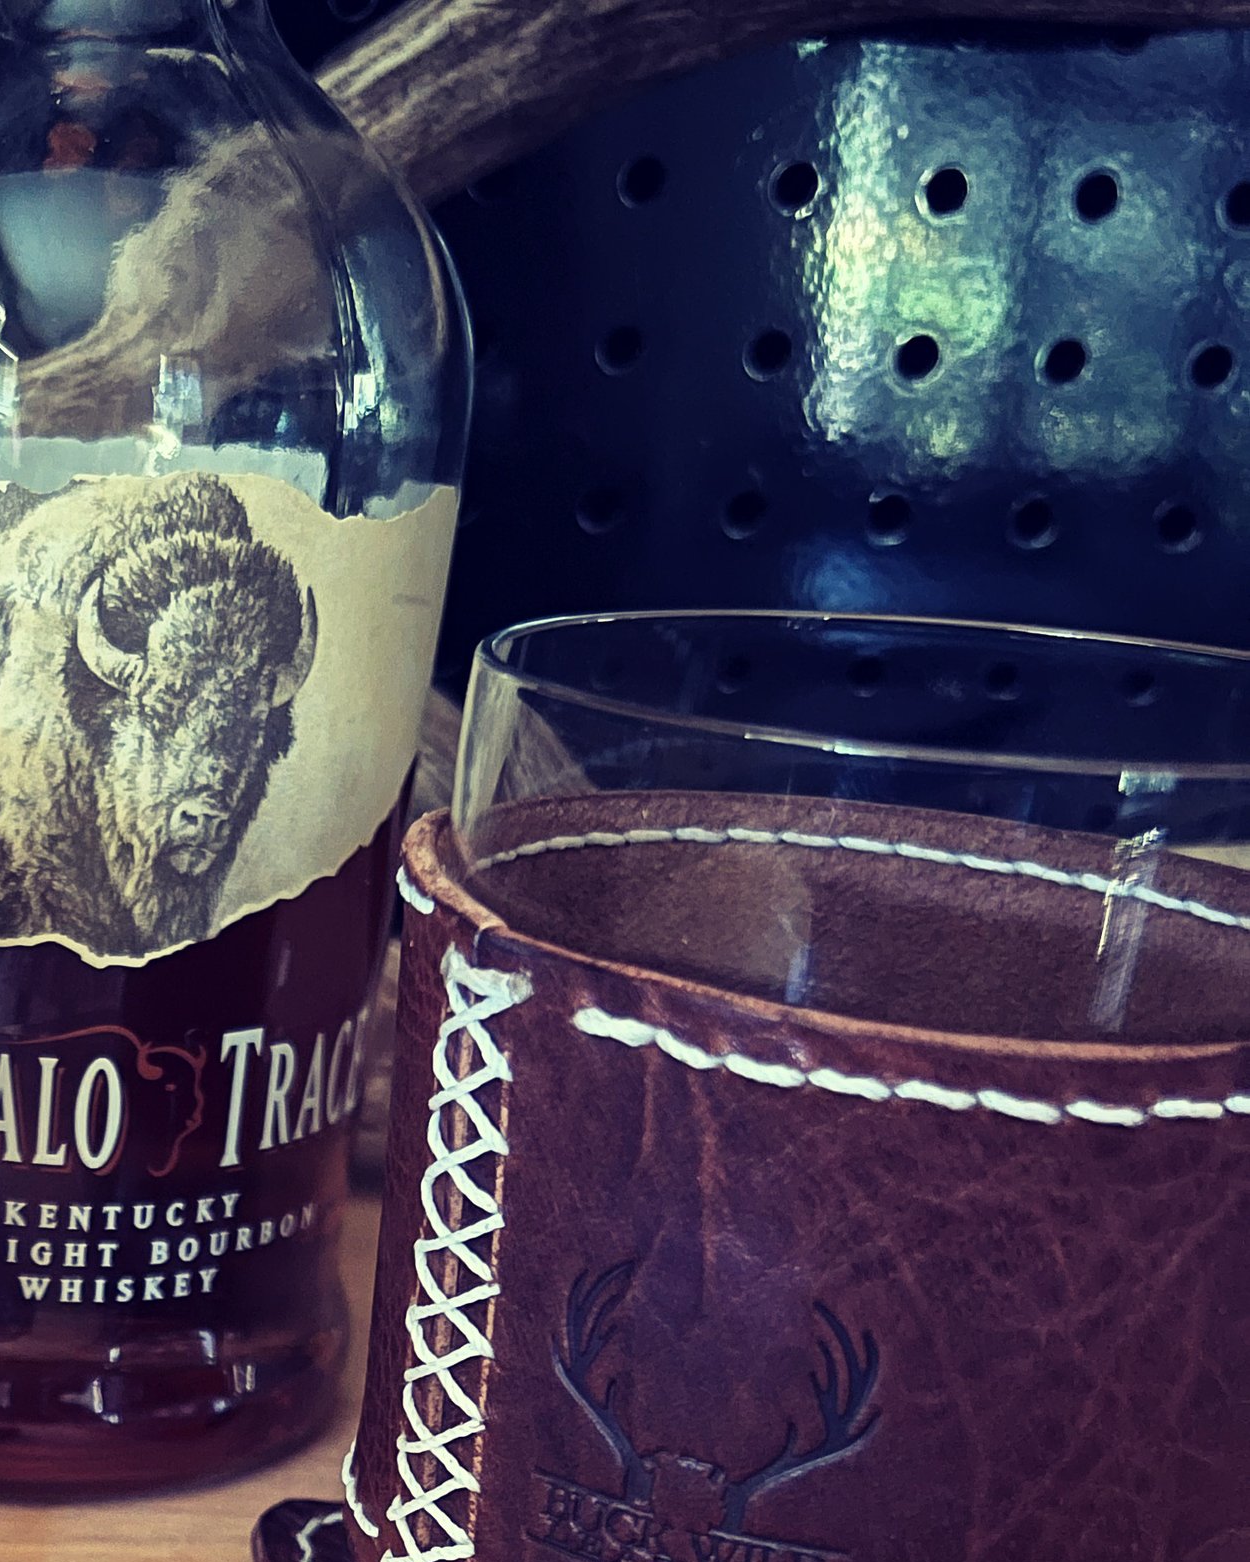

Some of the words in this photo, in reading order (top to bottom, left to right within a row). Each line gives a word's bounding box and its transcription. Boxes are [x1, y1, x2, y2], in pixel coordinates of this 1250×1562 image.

[3, 1193, 241, 1233] KENTUCKY
[150, 1203, 317, 1265] BOURBON
[18, 1268, 218, 1304] WHISKEY
